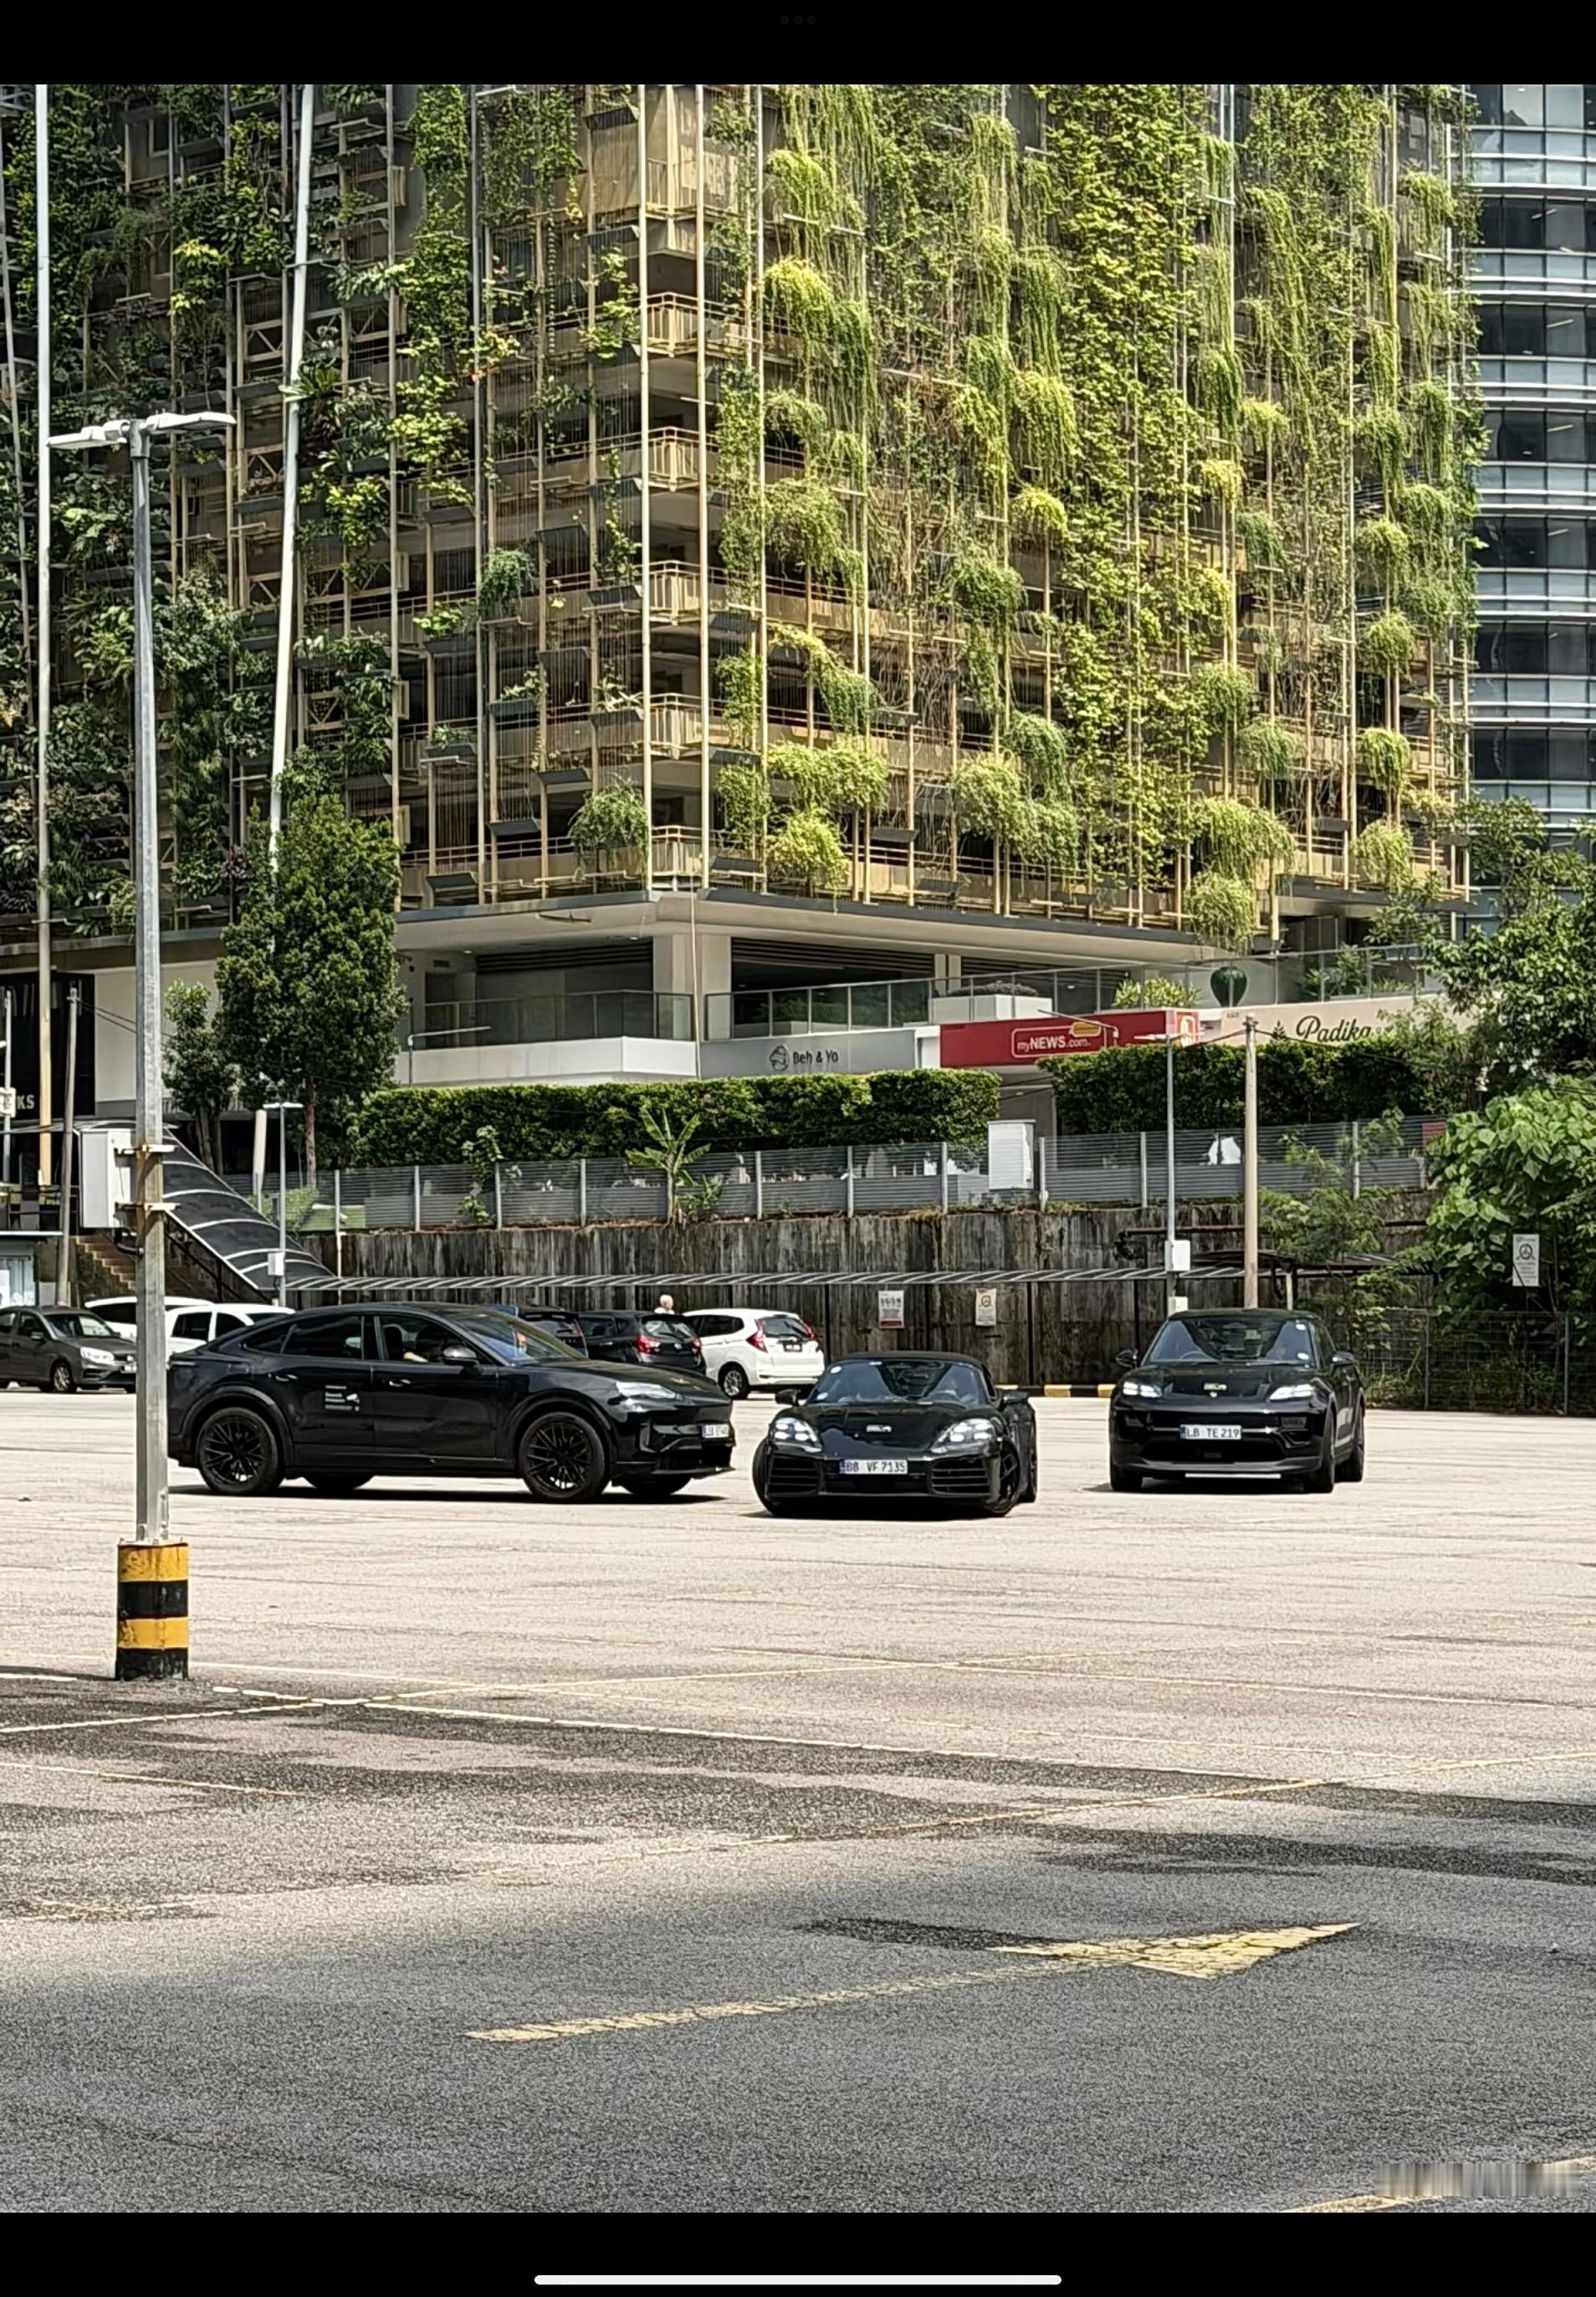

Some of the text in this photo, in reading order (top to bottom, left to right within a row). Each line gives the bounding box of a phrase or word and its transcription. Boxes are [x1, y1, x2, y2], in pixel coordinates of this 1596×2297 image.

[1296, 1015, 1372, 1042] Padika
[793, 1051, 812, 1064] Beh
[816, 1051, 822, 1062] &
